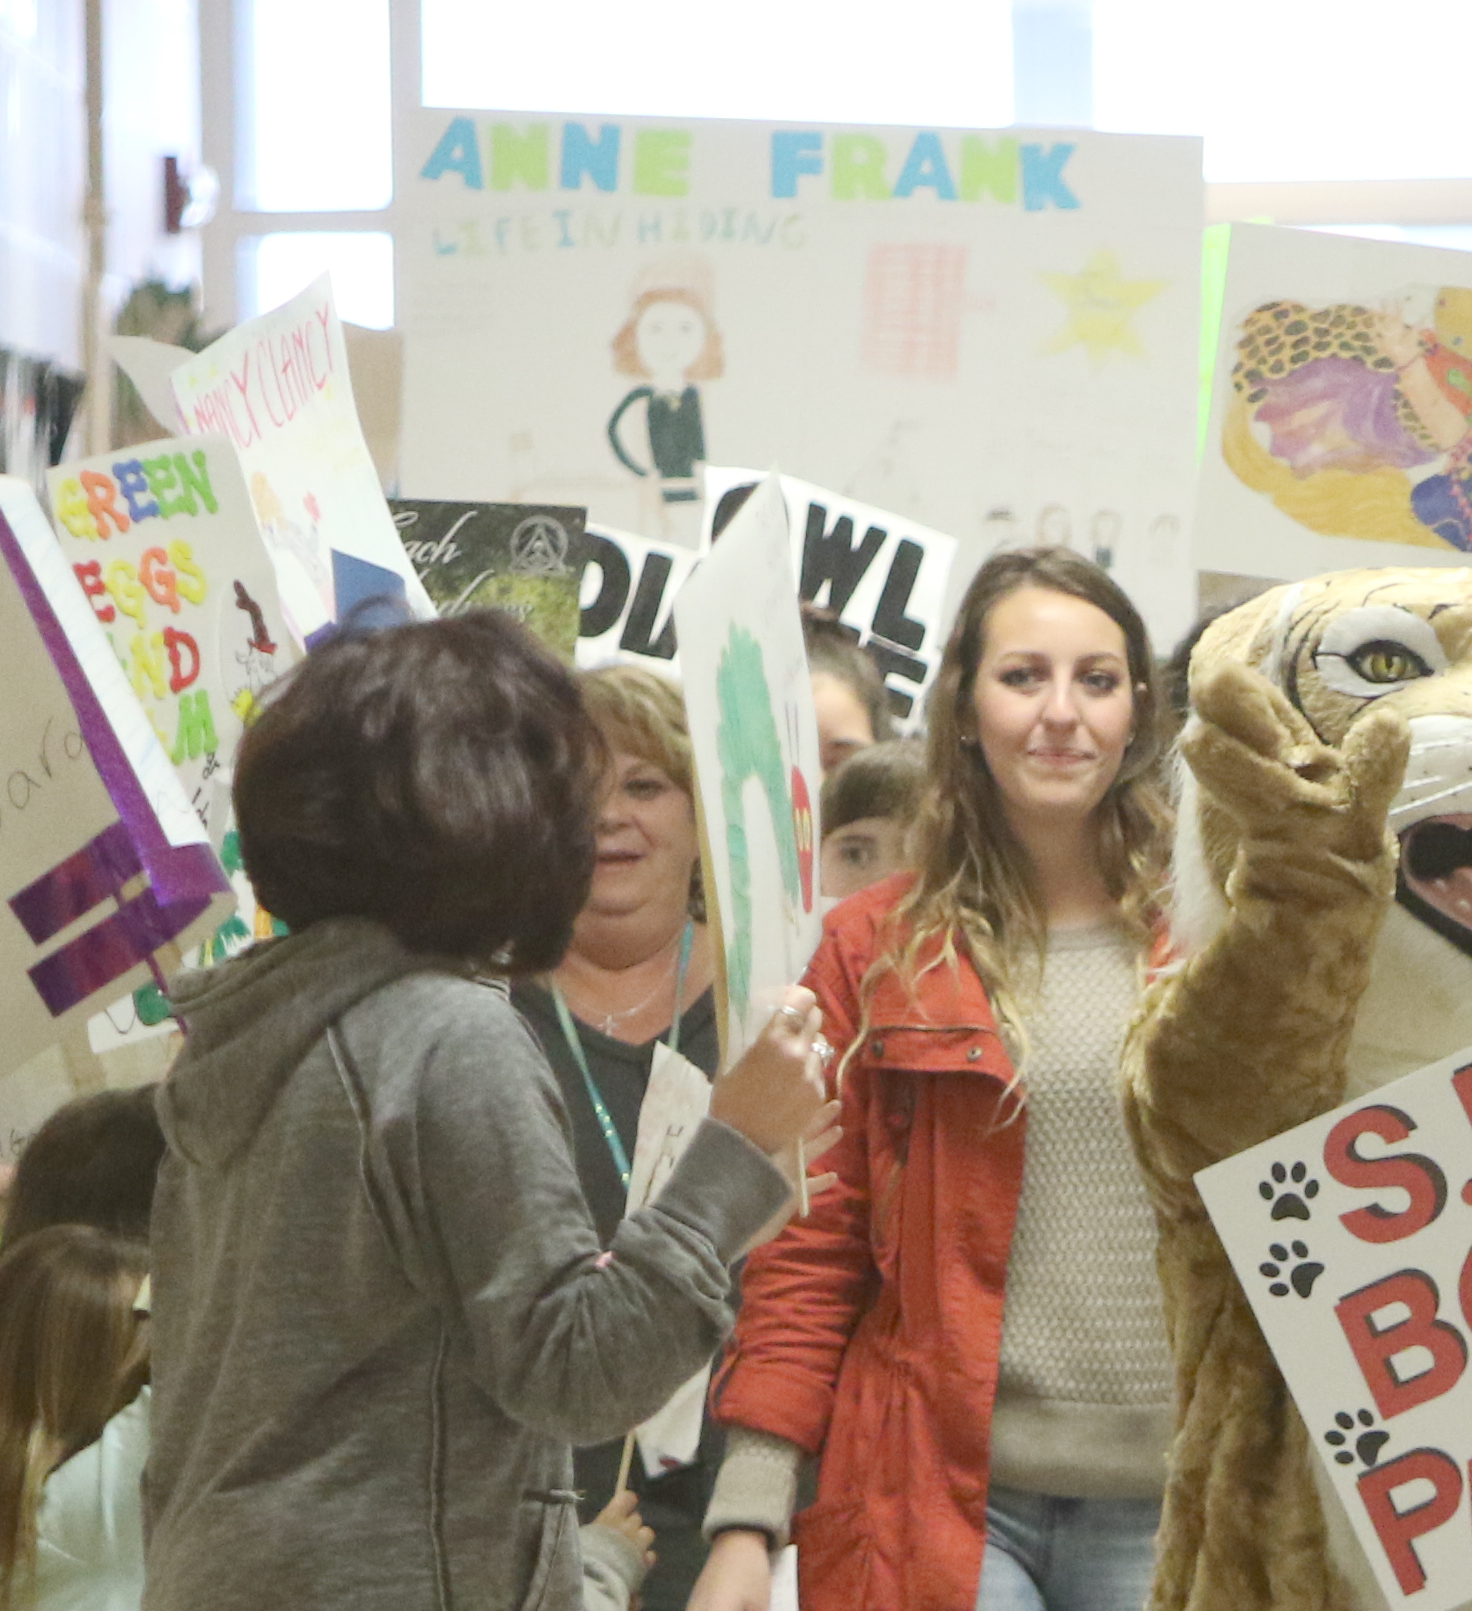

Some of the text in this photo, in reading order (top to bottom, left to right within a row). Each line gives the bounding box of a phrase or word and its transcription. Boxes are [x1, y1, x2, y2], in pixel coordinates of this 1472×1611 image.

[420, 116, 1081, 212] ANNE FRANK
[431, 205, 809, 257] LIFE IN HIDING
[56, 449, 219, 542] GREEN
[72, 539, 208, 630] EGGS
[106, 626, 201, 700] ND
